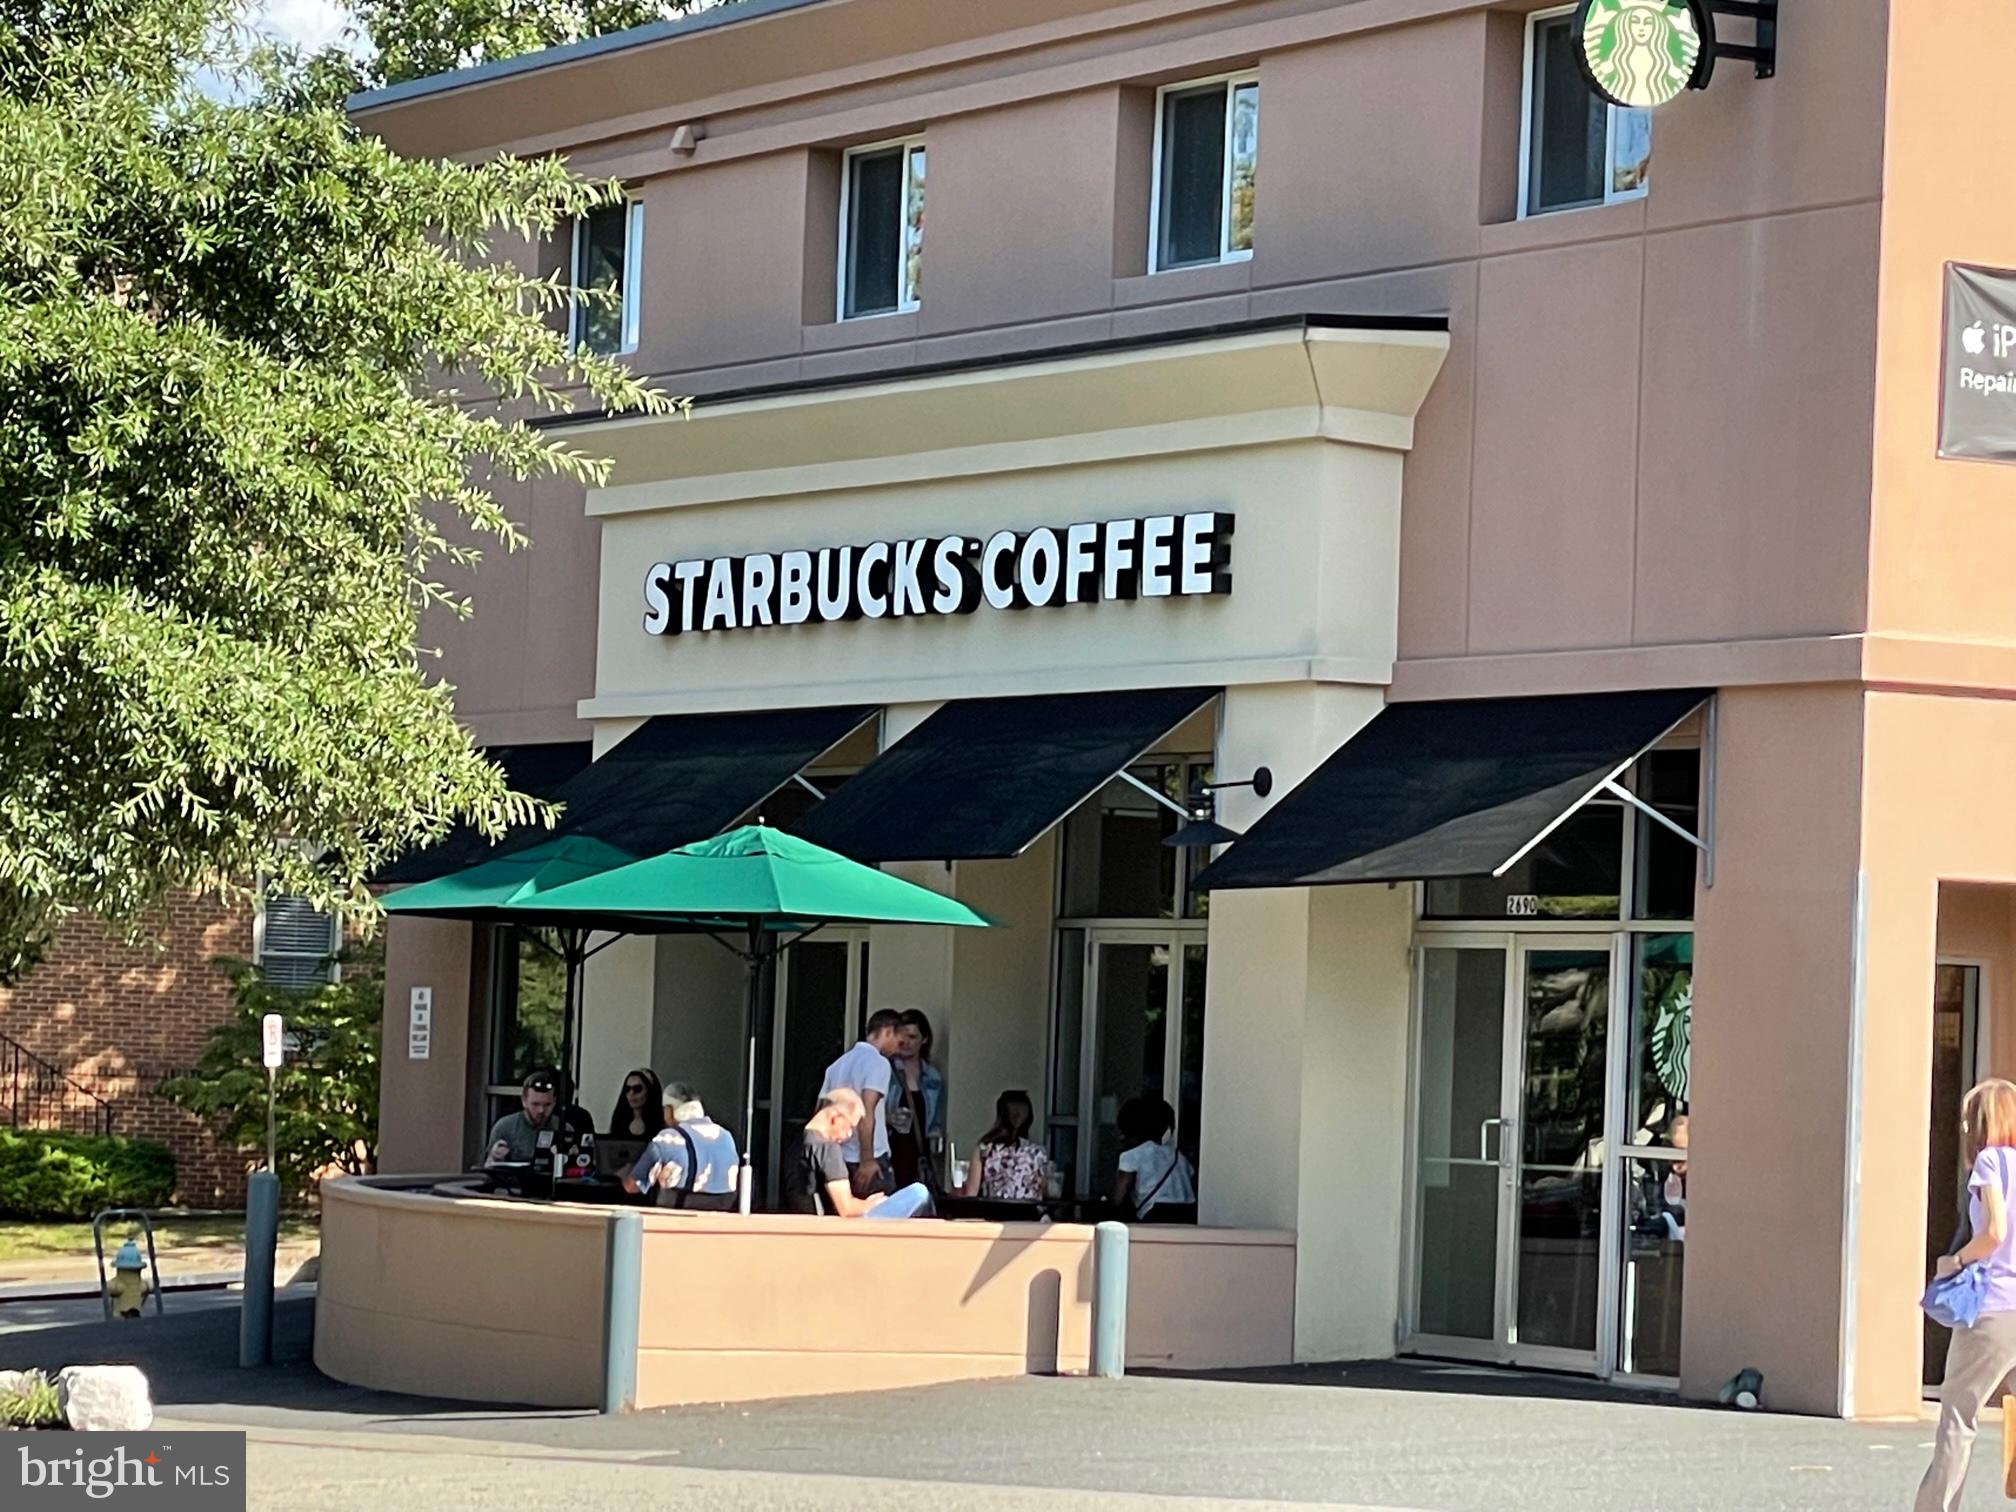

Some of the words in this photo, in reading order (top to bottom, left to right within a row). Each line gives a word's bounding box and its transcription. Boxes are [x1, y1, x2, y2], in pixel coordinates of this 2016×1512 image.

[644, 535, 964, 635] STARBUCKS
[981, 511, 1216, 610] COFFEE
[1509, 897, 1536, 914] 2690
